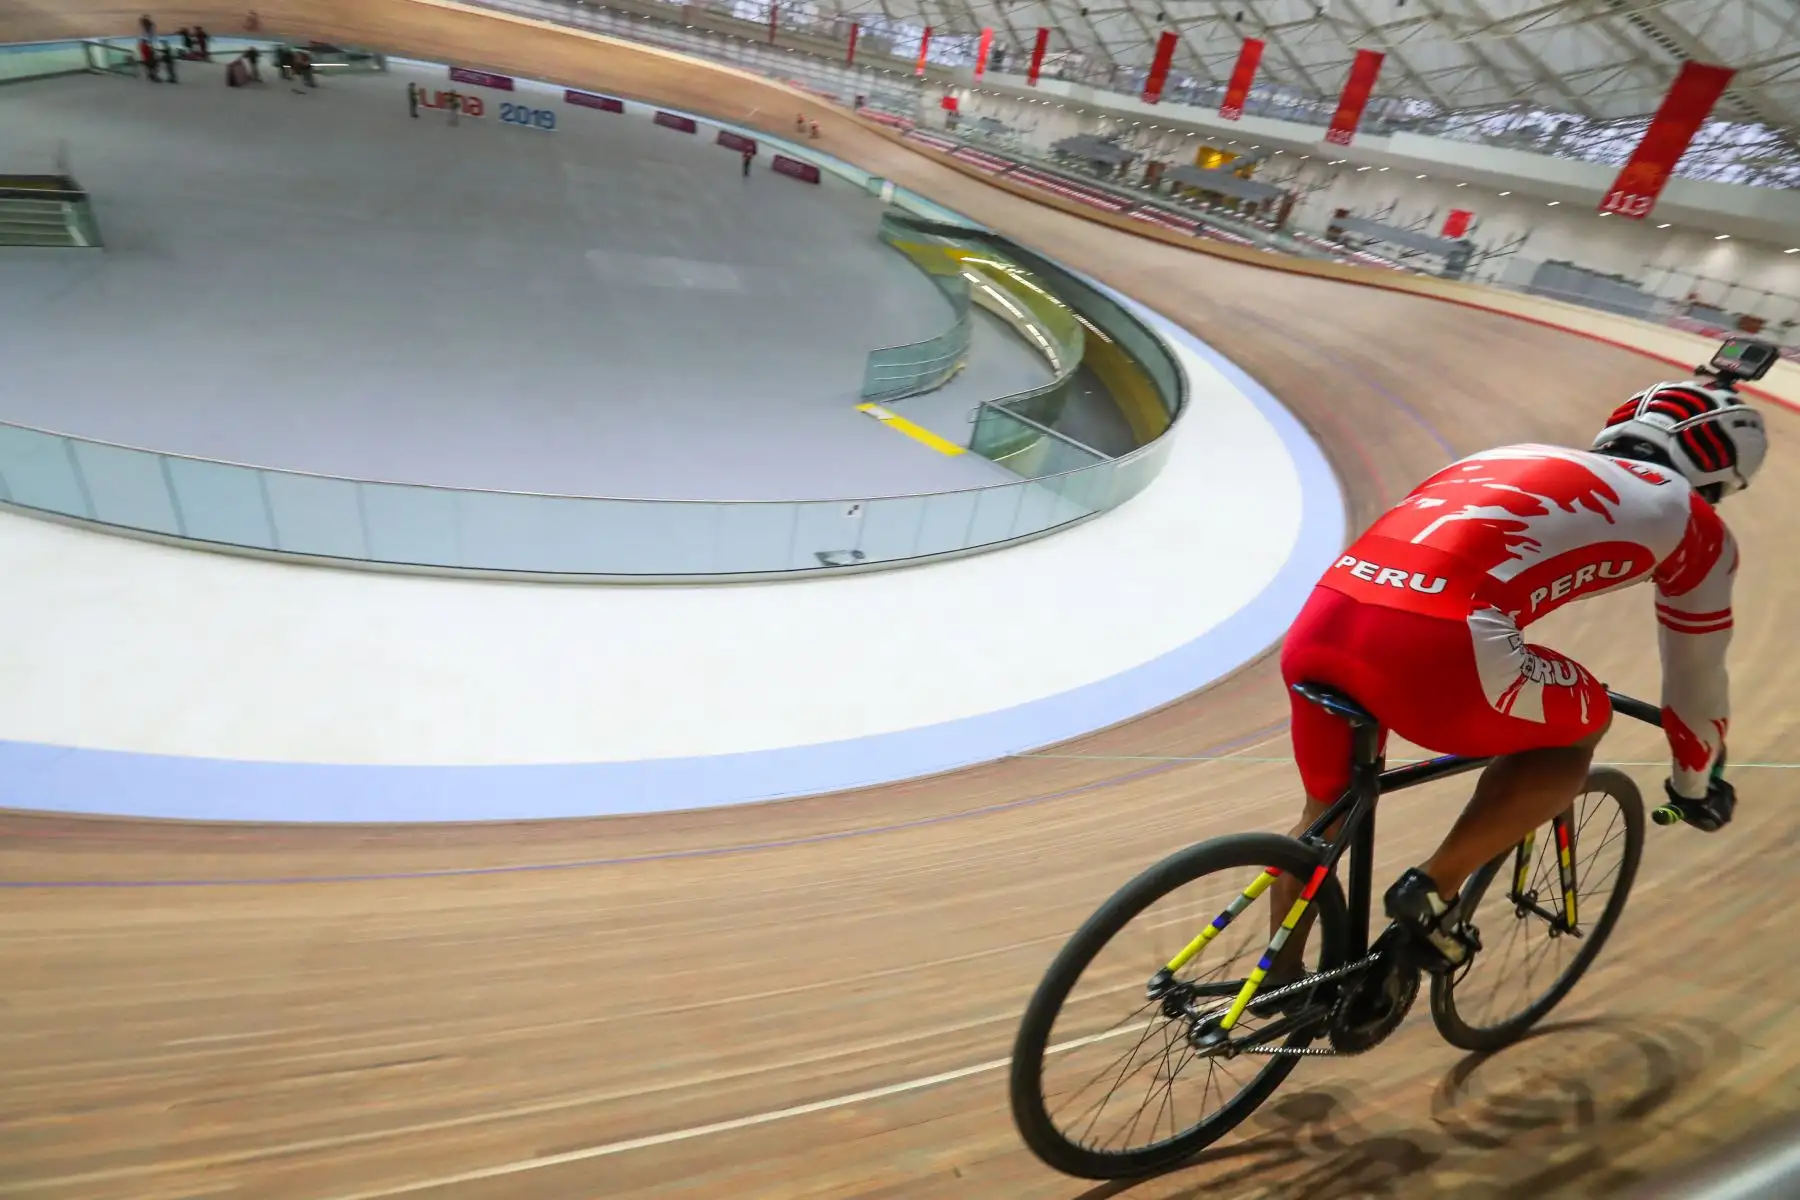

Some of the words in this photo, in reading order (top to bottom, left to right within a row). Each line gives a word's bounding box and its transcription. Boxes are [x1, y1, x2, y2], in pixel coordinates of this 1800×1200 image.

[500, 102, 556, 129] 2019
[1604, 190, 1651, 216] 113
[1334, 555, 1448, 594] PERU
[1530, 560, 1633, 613] PERU
